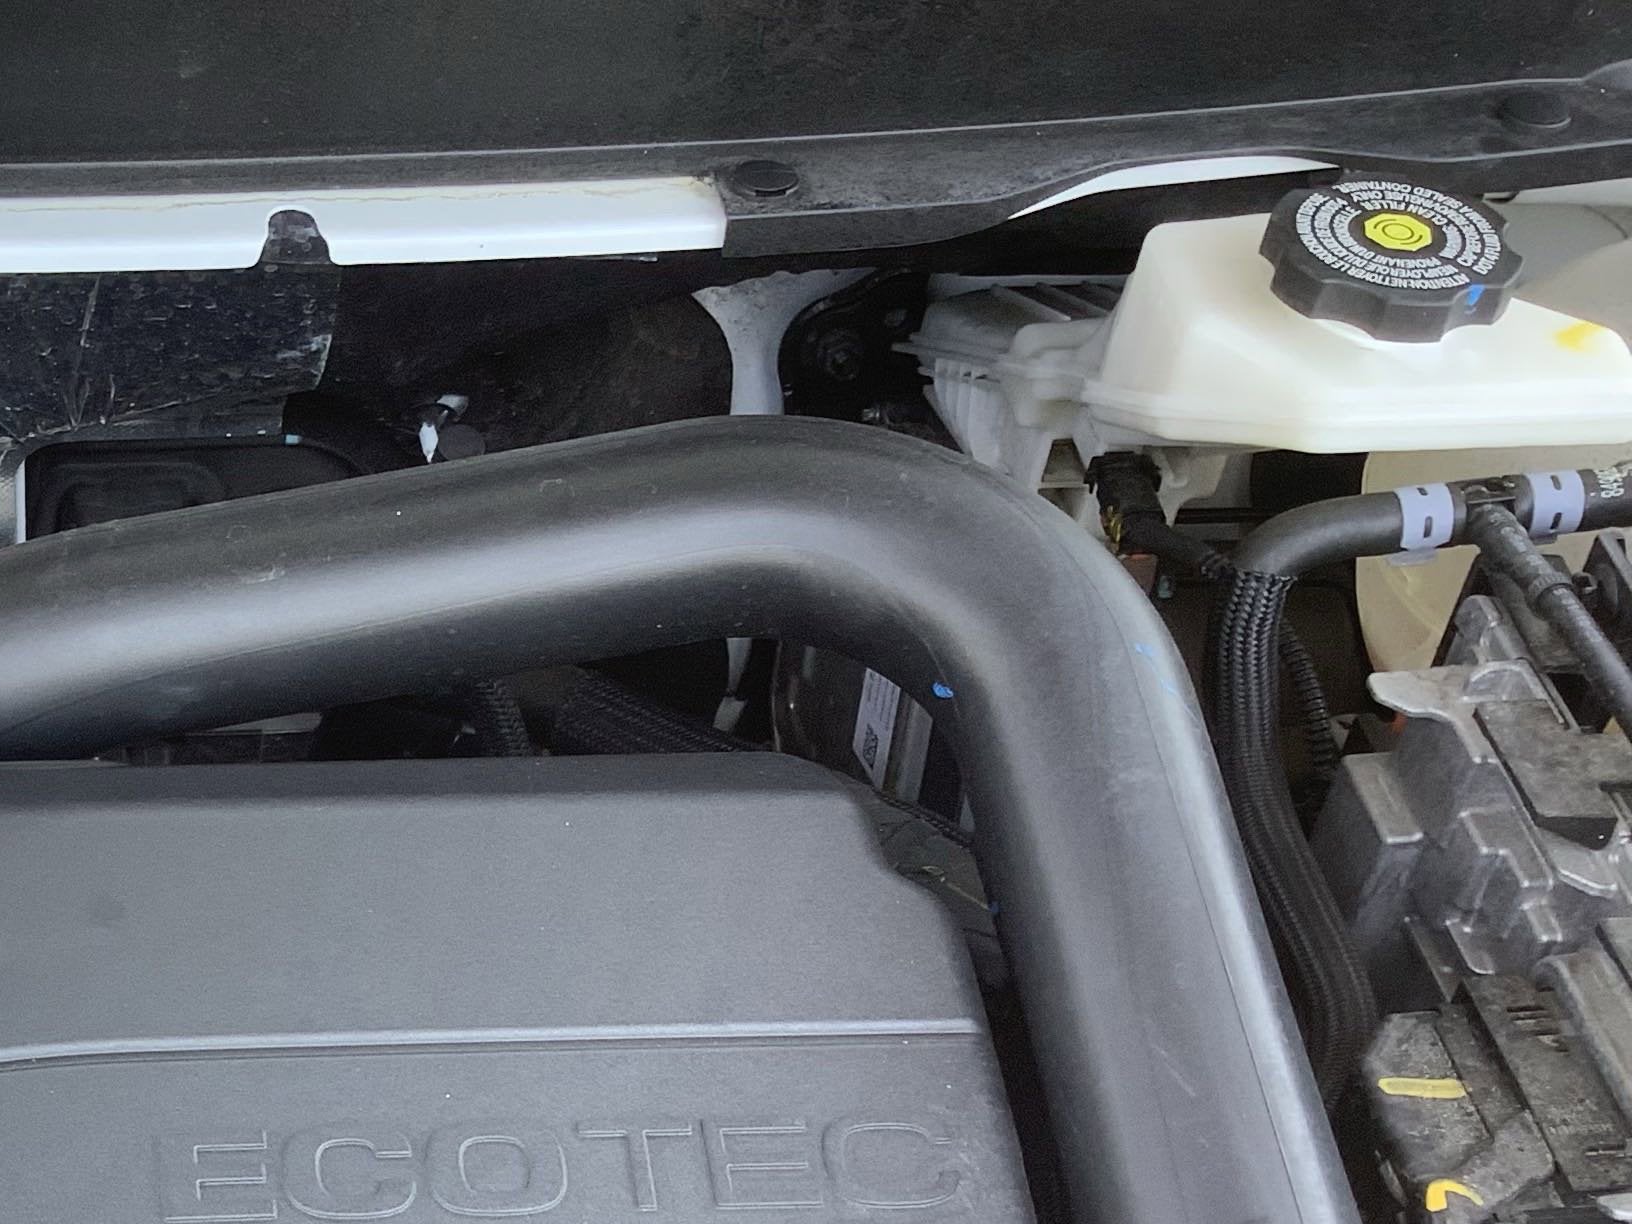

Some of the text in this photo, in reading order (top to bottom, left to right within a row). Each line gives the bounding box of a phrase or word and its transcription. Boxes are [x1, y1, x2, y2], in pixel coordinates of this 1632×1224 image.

[1360, 200, 1406, 210] FILLER
[1414, 187, 1462, 209] SEALED
[1408, 204, 1448, 225] CLEAN
[1364, 262, 1390, 274] QUE
[163, 1112, 962, 1224] ECOTEC
